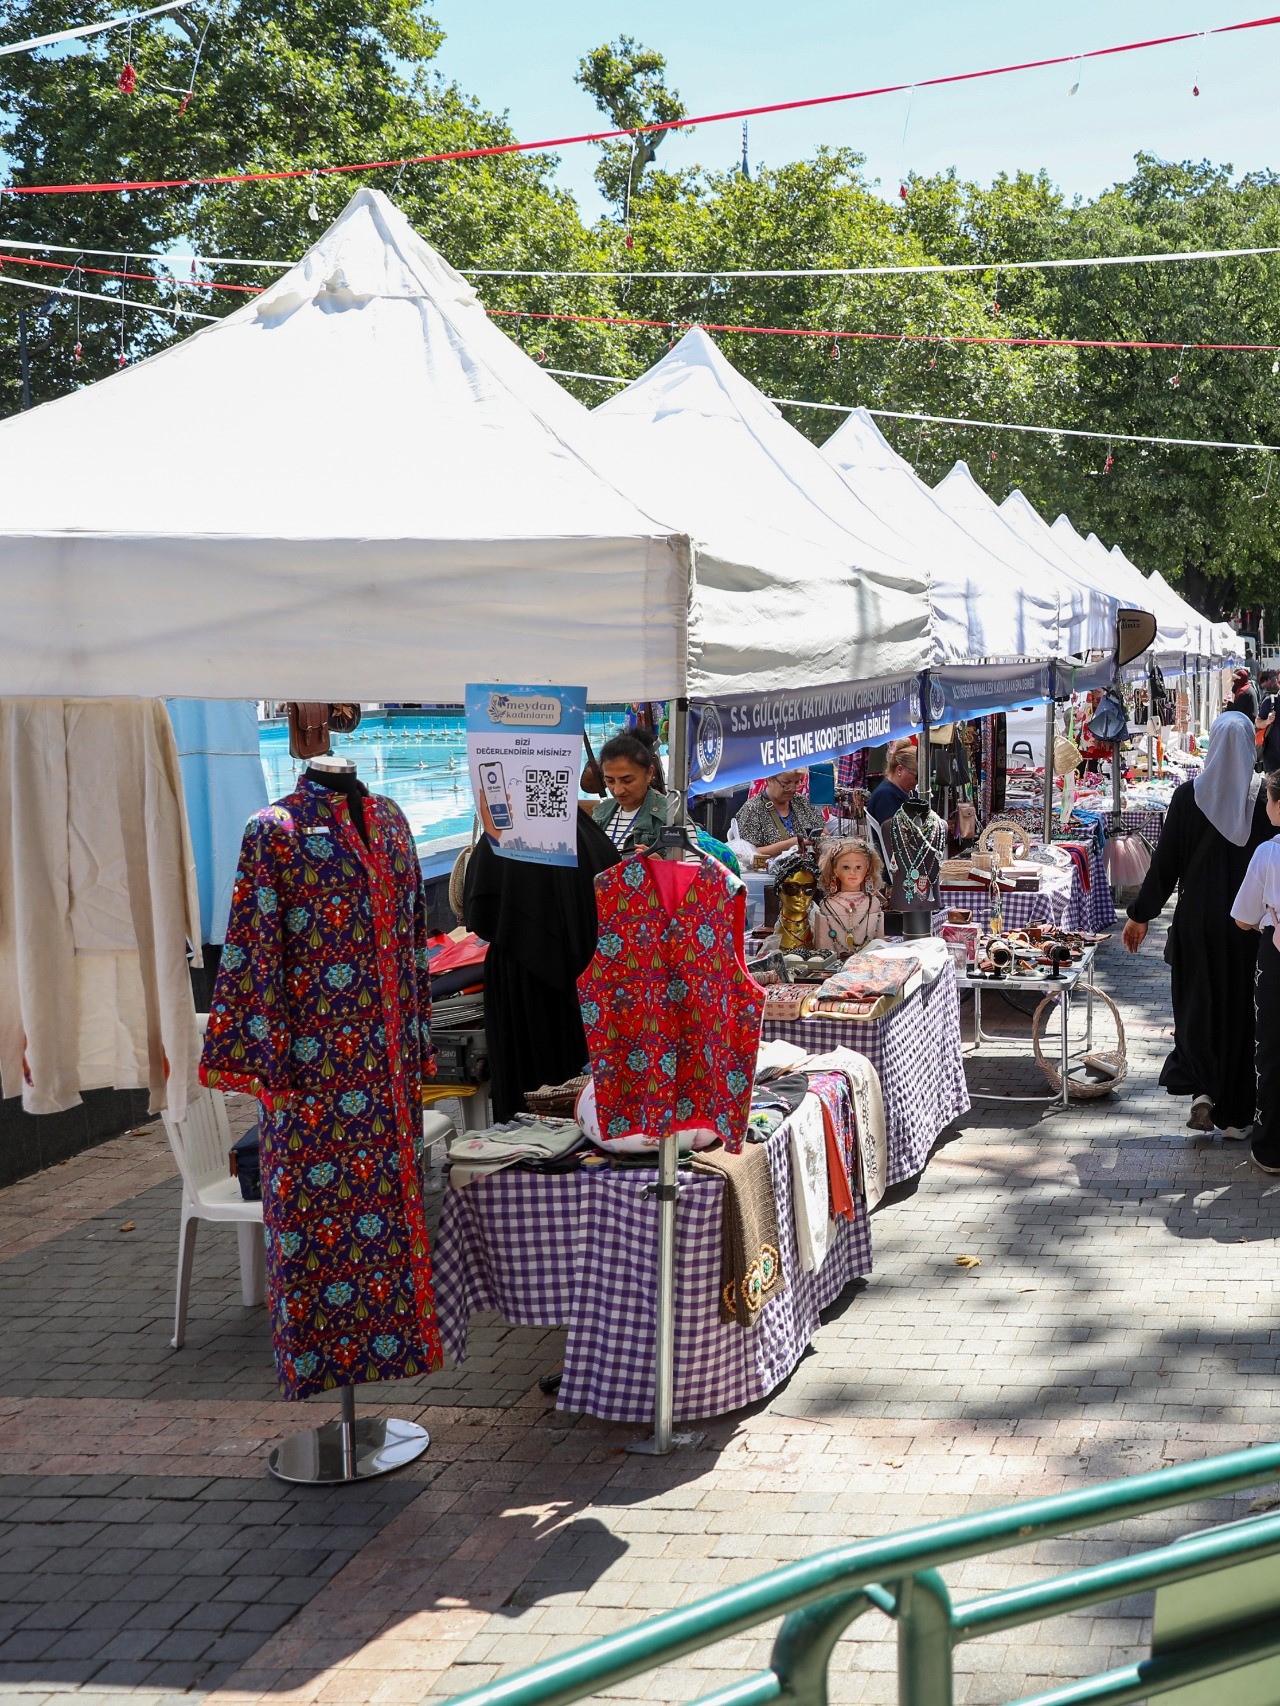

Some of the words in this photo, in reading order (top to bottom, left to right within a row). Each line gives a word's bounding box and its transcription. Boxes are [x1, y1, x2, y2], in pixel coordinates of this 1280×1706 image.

[506, 702, 555, 712] meydan
[730, 706, 750, 732] S.S.
[752, 694, 800, 732] GÜLÇİÇEK
[802, 694, 831, 719] HATUN
[832, 692, 855, 714] KADIN
[760, 740, 775, 766] VE
[776, 730, 814, 768] İŞLETME
[814, 714, 868, 752] KOOPETİFLERİ
[868, 709, 891, 738] BİRLİĞİ
[476, 747, 535, 756] DEĞERLENDİRİR
[536, 748, 572, 756] MİSİNİZ?
